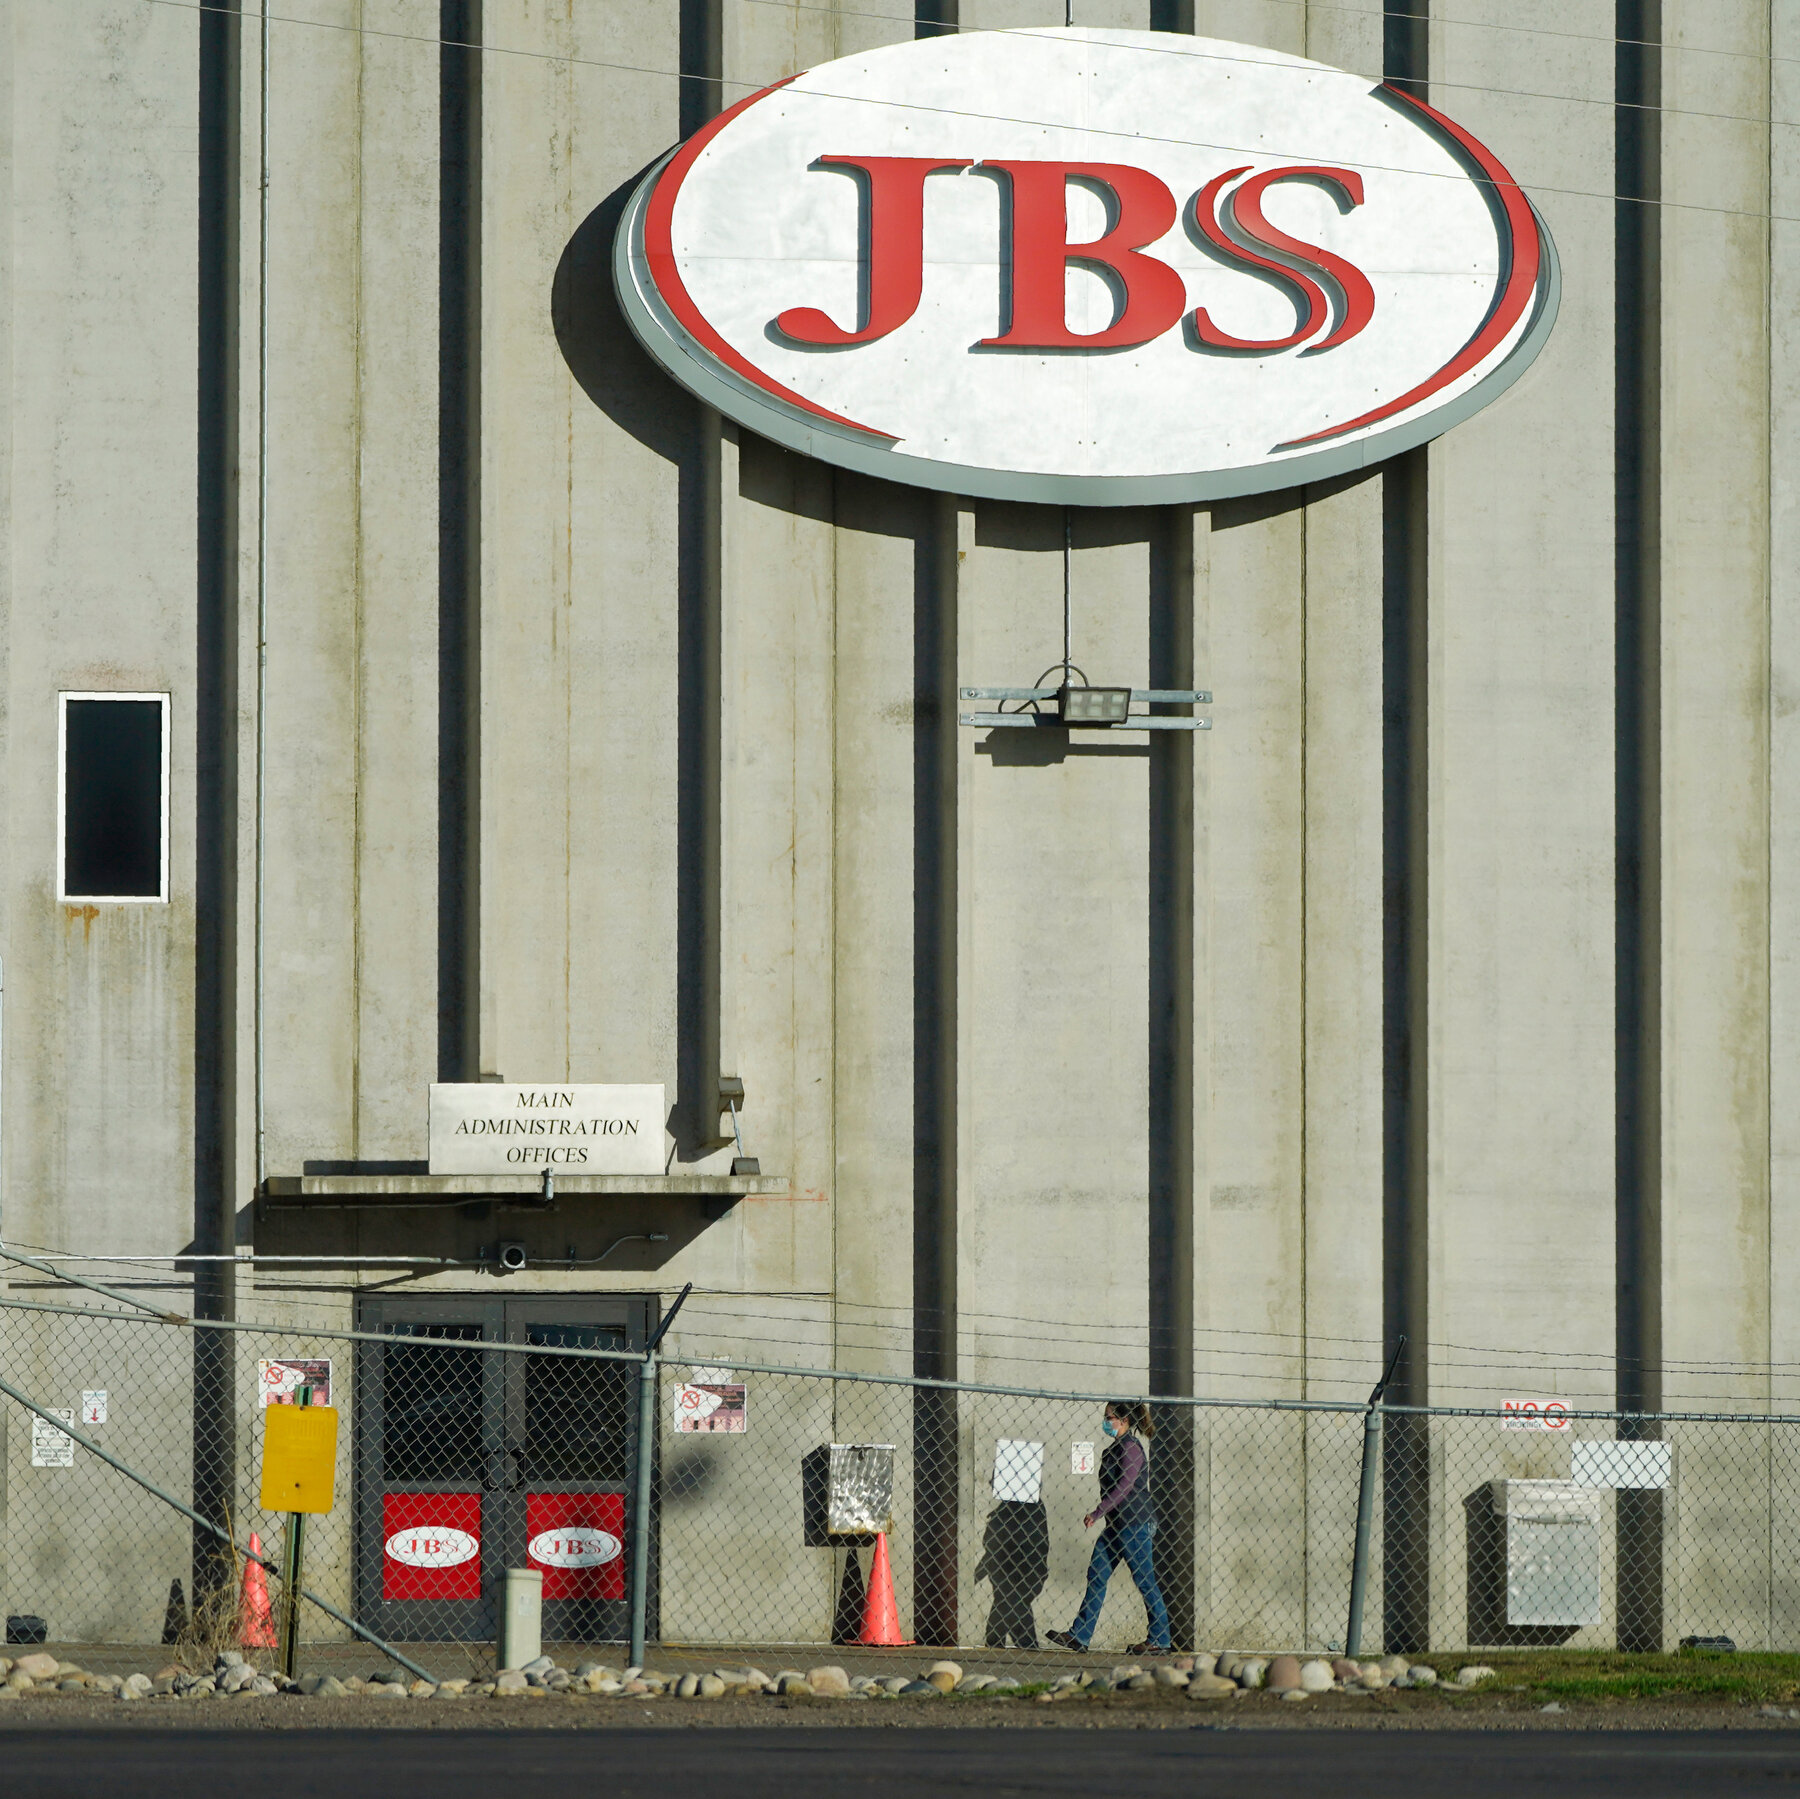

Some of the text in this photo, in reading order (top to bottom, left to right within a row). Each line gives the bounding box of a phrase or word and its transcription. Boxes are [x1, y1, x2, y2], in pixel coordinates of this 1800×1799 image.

[775, 155, 1375, 353] JBS
[516, 1092, 574, 1108] MAIN
[455, 1119, 639, 1136] ADMINISTRATION
[506, 1147, 588, 1164] OFFICES
[404, 1539, 459, 1554] JBS
[547, 1540, 602, 1555] JBS
